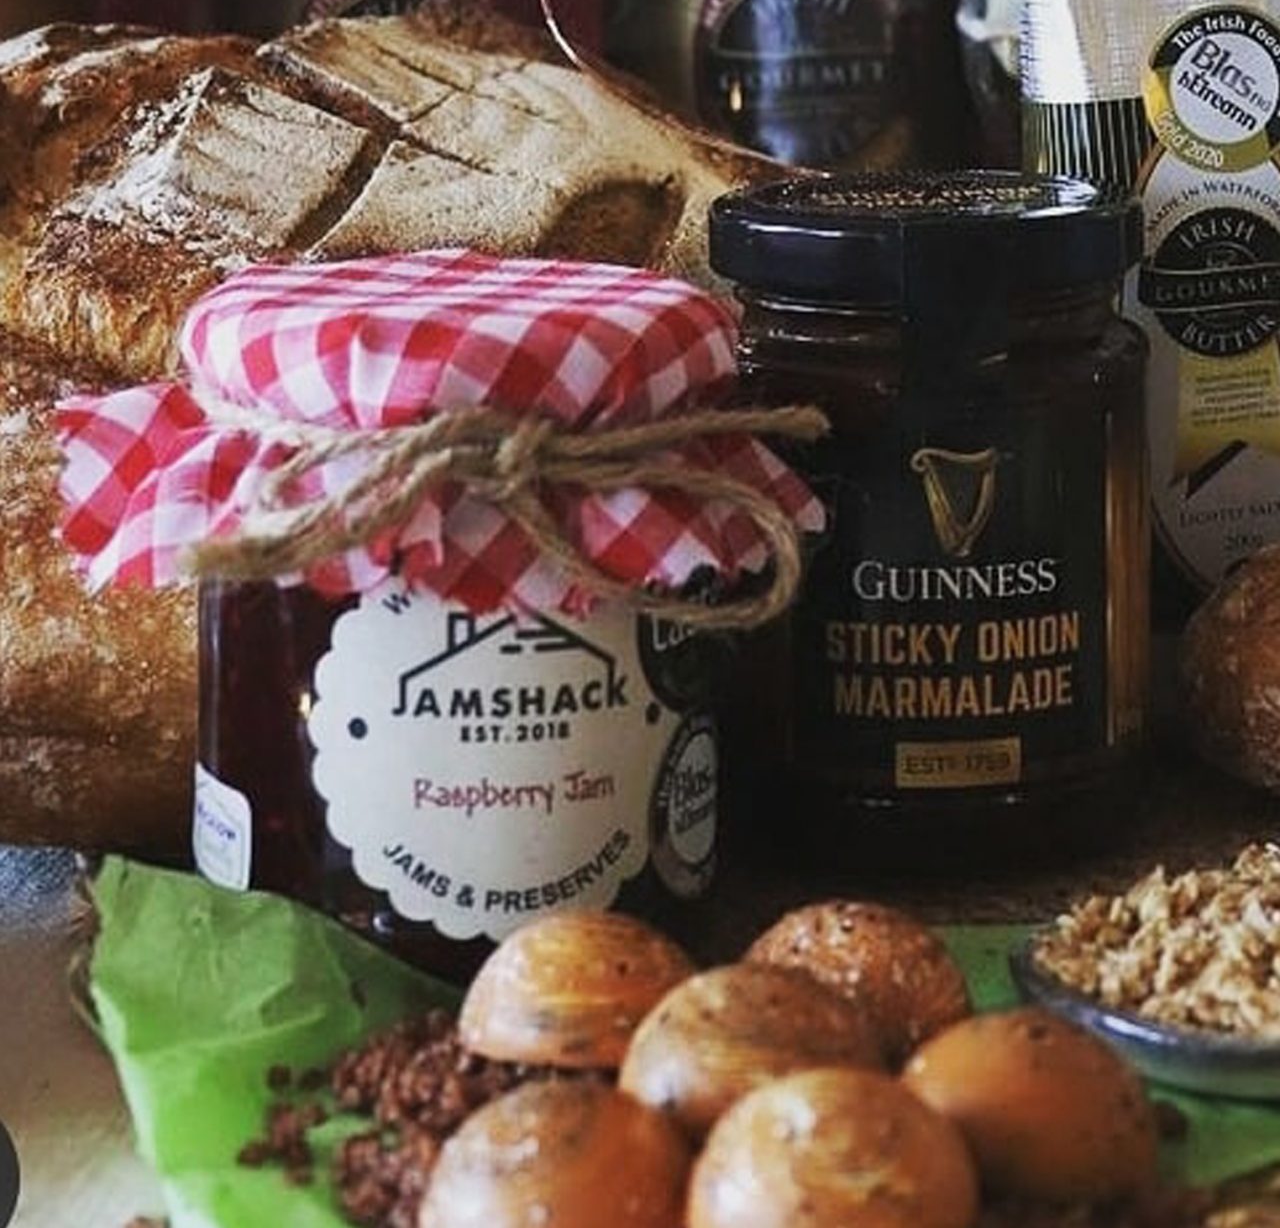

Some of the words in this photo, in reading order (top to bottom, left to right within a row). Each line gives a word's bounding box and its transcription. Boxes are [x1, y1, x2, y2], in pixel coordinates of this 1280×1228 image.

[1172, 22, 1205, 50] The
[1203, 14, 1246, 33] Irish
[1190, 38, 1257, 98] Blas
[1178, 217, 1256, 250] IRISH
[852, 558, 1059, 603] GUINNESS
[825, 620, 962, 667] STICKY
[976, 609, 1082, 665] ONION
[391, 673, 629, 719] JAMSHACK
[833, 664, 1075, 719] MARMALADE
[412, 776, 555, 819] Raspberry
[562, 769, 617, 802] Jam
[382, 842, 451, 899] JAMS
[455, 884, 476, 910] &
[483, 828, 633, 914] PRESERVES
